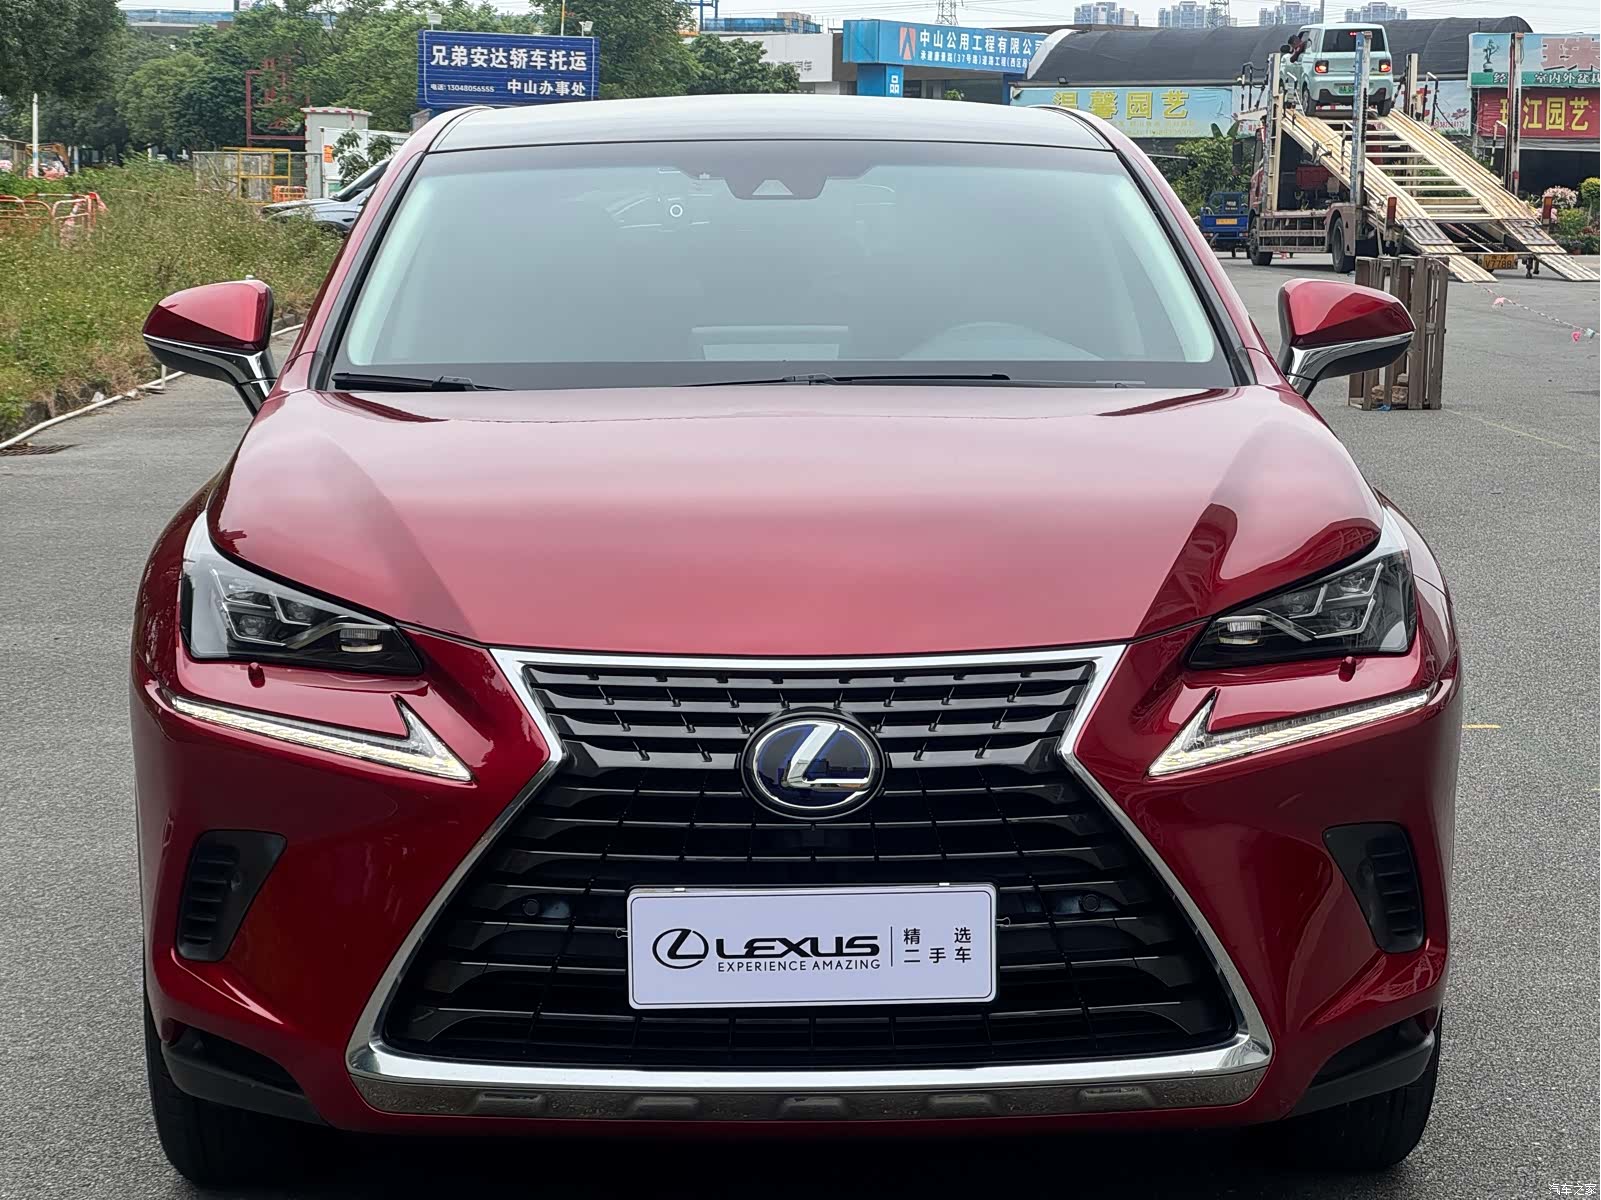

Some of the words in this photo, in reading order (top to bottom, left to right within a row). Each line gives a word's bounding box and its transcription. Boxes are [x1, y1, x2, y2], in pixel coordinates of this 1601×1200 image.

[430, 45, 588, 71] 兄弟安达轿车托运
[507, 79, 586, 96] 中山办事处
[1053, 89, 1190, 120] 温馨园艺
[716, 936, 880, 958] LEXUS
[903, 947, 972, 963] 二手车
[718, 960, 807, 972] EXPERIENCE
[812, 958, 881, 971] AMAZING
